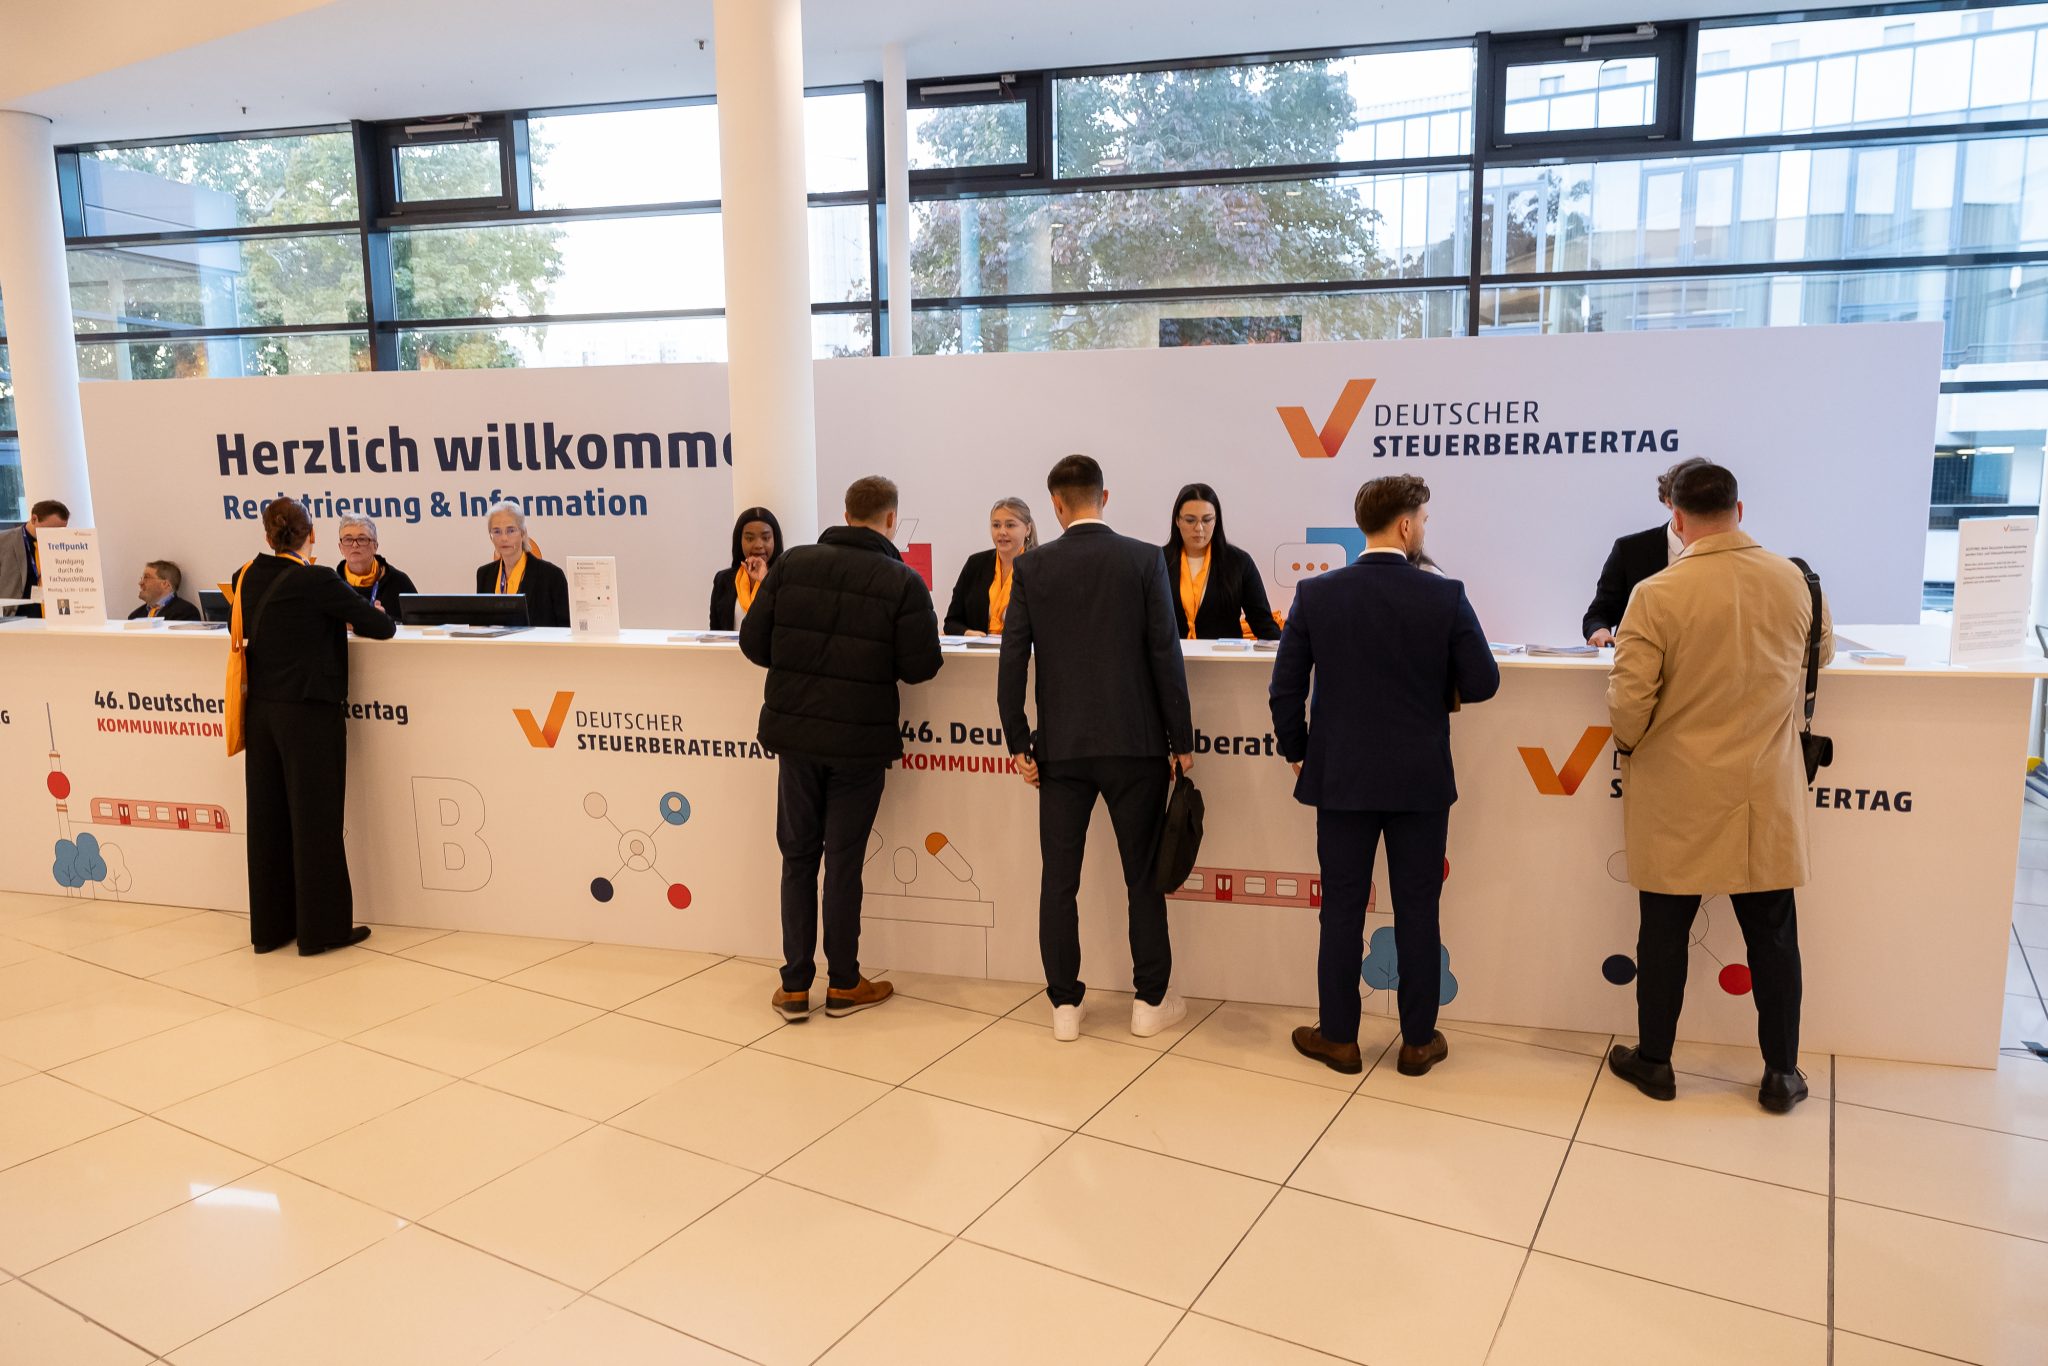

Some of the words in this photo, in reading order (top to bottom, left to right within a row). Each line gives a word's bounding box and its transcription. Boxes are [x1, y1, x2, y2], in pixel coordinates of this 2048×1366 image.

[1374, 400, 1540, 427] DEUTSCHER
[216, 425, 420, 476] Herzlich
[1372, 428, 1680, 458] STEUERBERATERTAG
[223, 490, 422, 524] Retrierung
[430, 491, 452, 517] &
[48, 542, 88, 552] Treffpunkt
[94, 690, 124, 710] 46.
[128, 691, 225, 714] Deutscher
[97, 717, 224, 738] KOMMUNIKATION
[575, 710, 684, 733] DEUTSCHER
[900, 720, 942, 744] 46.
[901, 752, 1023, 775] KOMMUNIK
